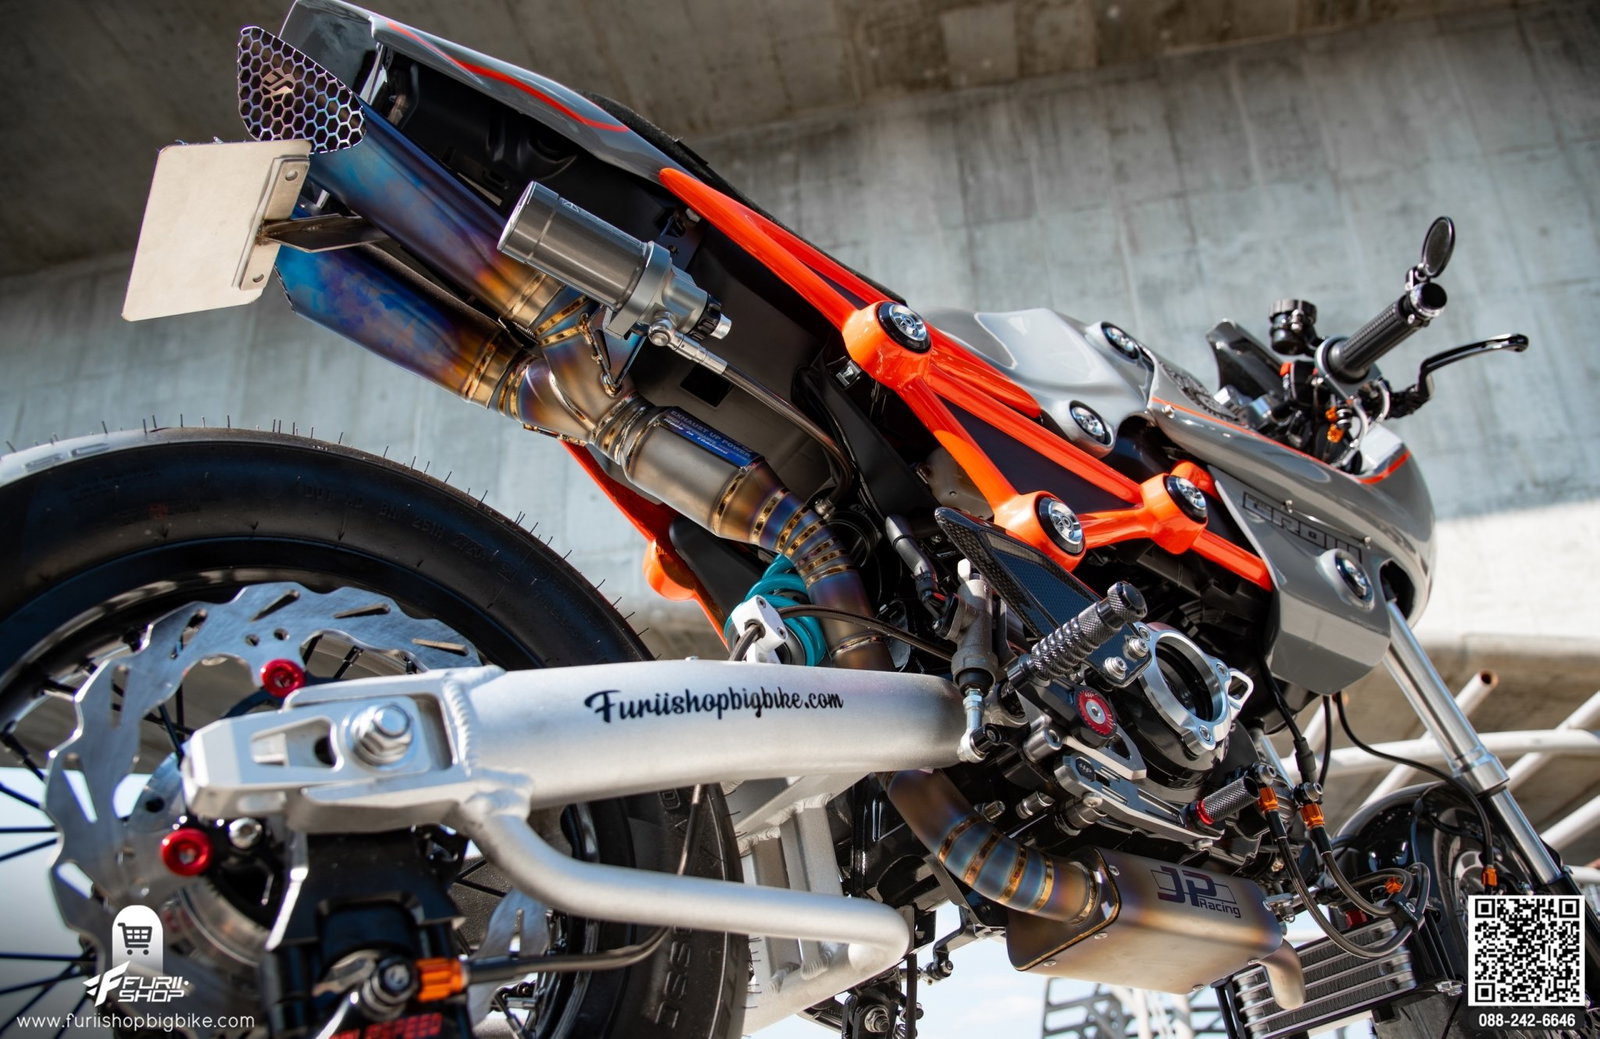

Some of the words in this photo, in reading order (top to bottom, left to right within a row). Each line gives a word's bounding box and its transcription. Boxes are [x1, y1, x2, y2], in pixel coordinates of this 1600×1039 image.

[670, 409, 708, 434] EXHAUST
[722, 438, 752, 458] POWER
[1199, 898, 1242, 919] Racing
